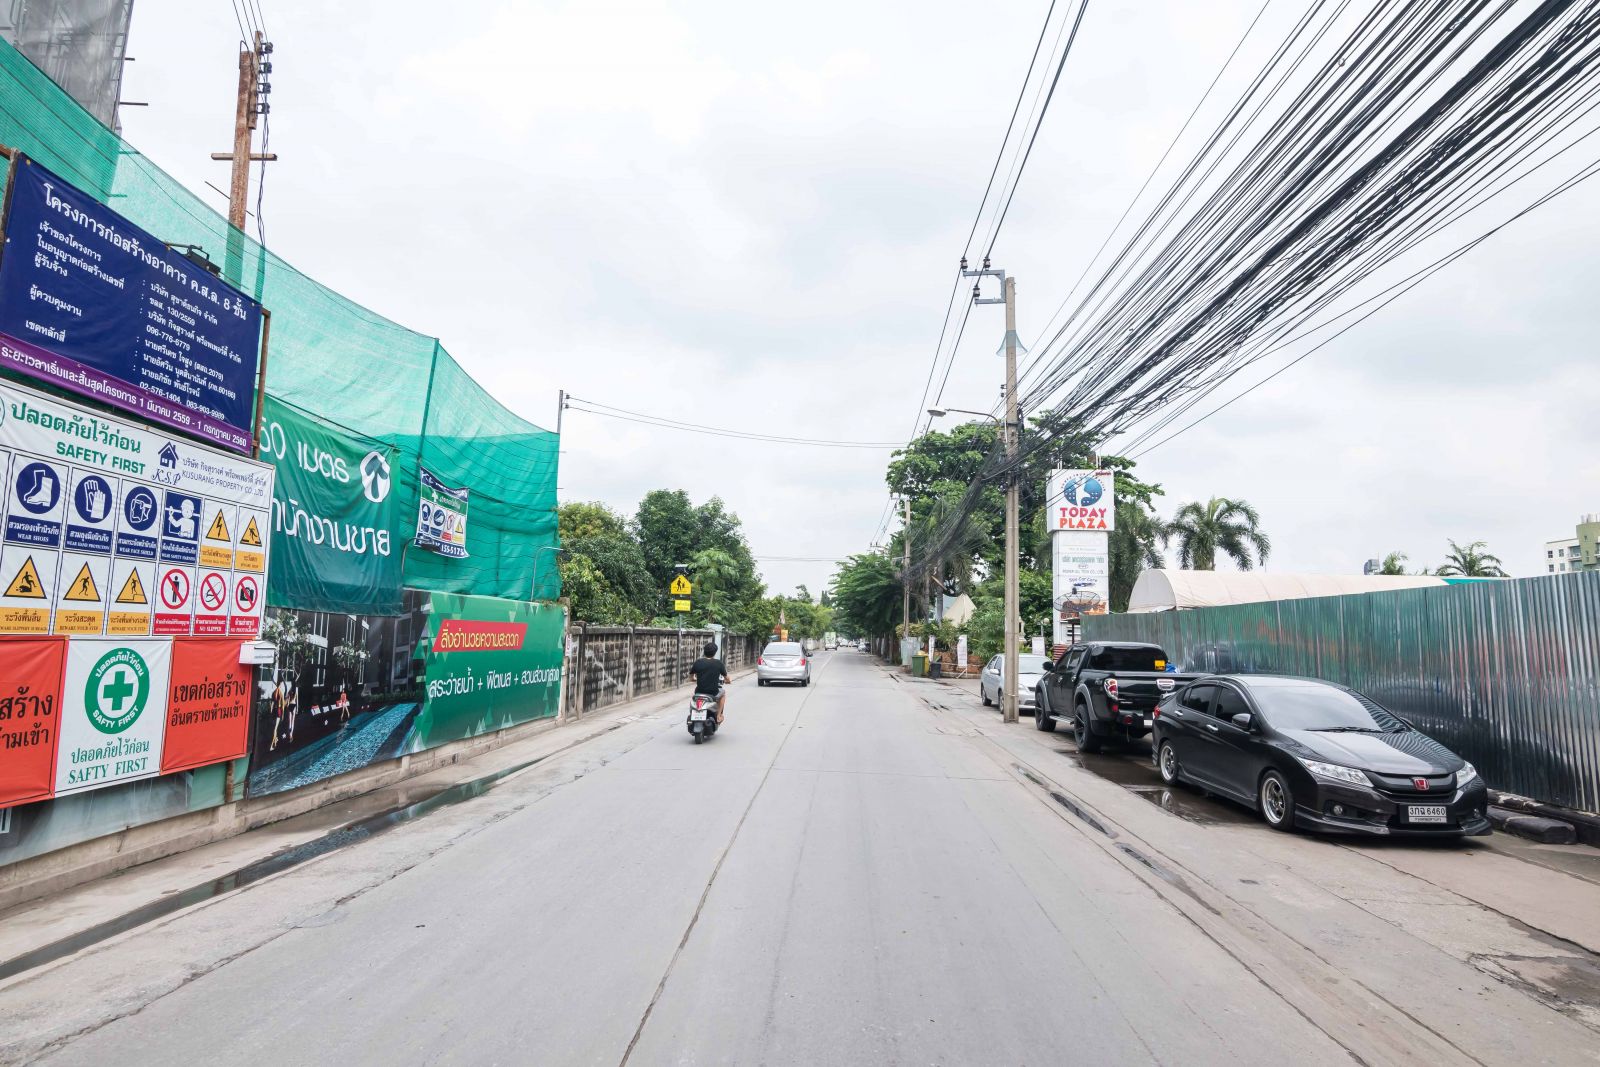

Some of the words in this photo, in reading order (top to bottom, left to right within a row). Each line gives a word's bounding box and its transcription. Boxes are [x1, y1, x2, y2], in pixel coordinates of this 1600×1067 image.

[34, 251, 68, 277] ผู้รับจ้าง
[42, 182, 187, 286] โครงการก่อสร้างอาคาร
[223, 298, 230, 310] 8
[232, 297, 247, 320] ชั้น
[29, 283, 82, 317] ผู้ควบคุมงาน
[1, 345, 137, 405] ระยะเวลาเริ่มและสิ้นสุดโครงการ
[139, 398, 144, 408] 1
[146, 400, 171, 419] มีนาคม
[172, 411, 191, 426] 2559
[11, 401, 141, 454] ปลอดภัยไว้ก่อน
[56, 441, 108, 466] SAFETY
[111, 455, 146, 475] FIRST
[297, 441, 350, 483] เมตร
[216, 478, 243, 493] PROPERTY
[1060, 507, 1107, 518] TODAY
[1060, 518, 1107, 529] PLAZA
[440, 622, 520, 649] สิ่งอำนวยความสะดวก
[95, 651, 145, 678] ปลอดภัยไว้ก่อน
[173, 673, 246, 703] เขตก่อสร้าง
[428, 667, 475, 699] สระว่ายน้ำ
[486, 669, 512, 690] ฟิตเนส
[92, 709, 116, 729] SAFTY
[117, 704, 140, 727] FIRST
[71, 737, 150, 764] ปลอดภัยไว้ก่อน
[67, 763, 110, 784] SAFTY
[114, 757, 149, 776] FIRST
[1427, 806, 1446, 816] 6460
